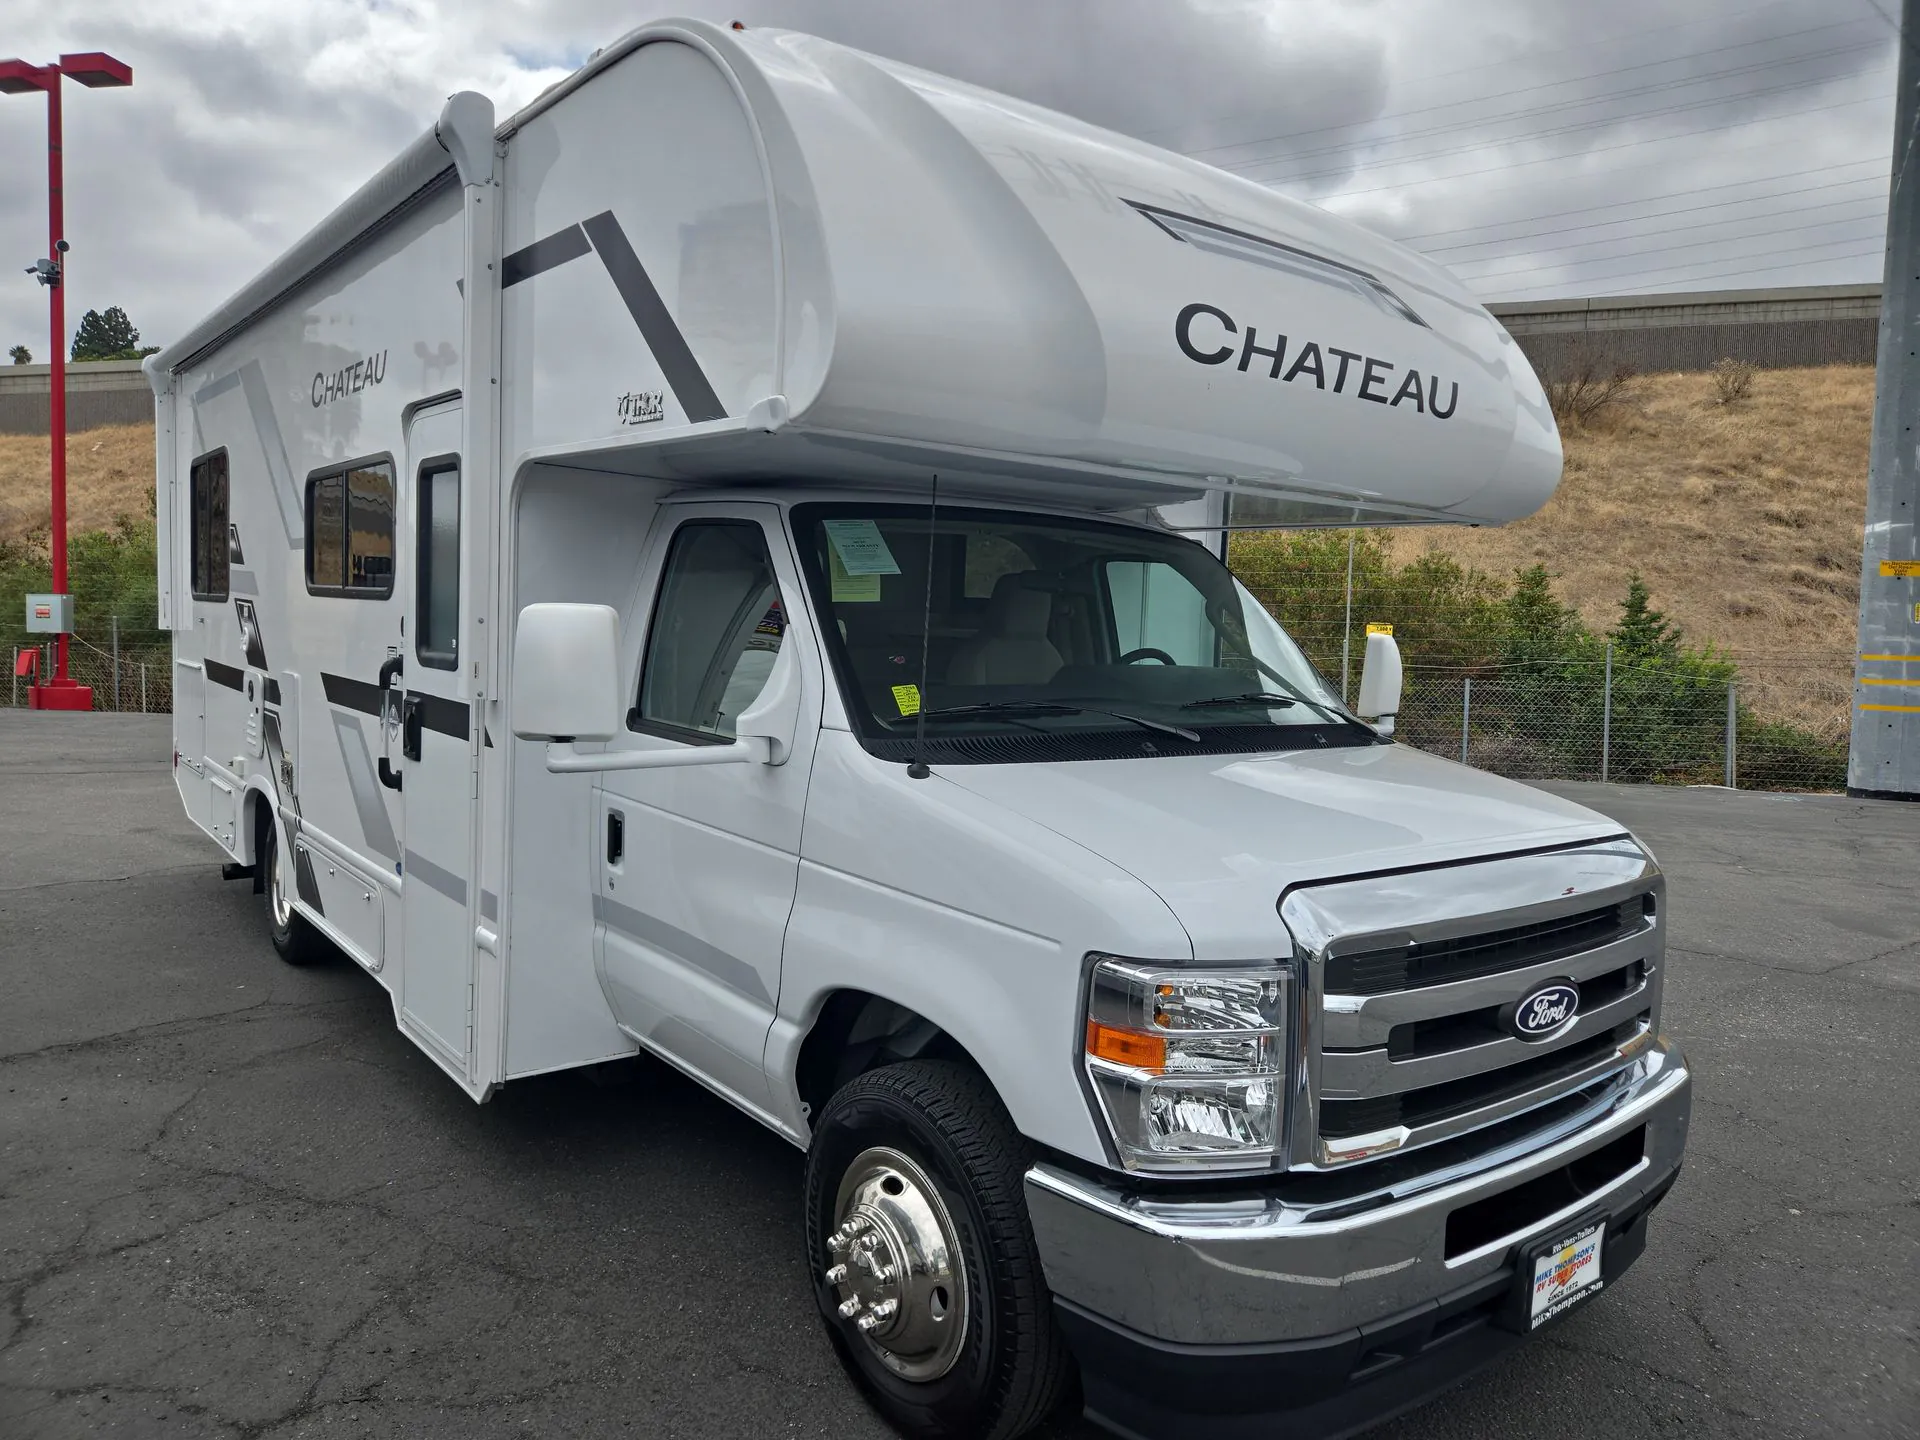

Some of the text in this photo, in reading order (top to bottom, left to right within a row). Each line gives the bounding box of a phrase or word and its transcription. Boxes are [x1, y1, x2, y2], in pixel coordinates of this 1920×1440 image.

[311, 349, 388, 408] CHATEAU
[1175, 302, 1459, 420] CHATEAU
[1528, 993, 1569, 1028] Ford
[1535, 1243, 1596, 1284] MIKE THOMPSON'S
[1536, 1253, 1593, 1293] RV SUPER STORES
